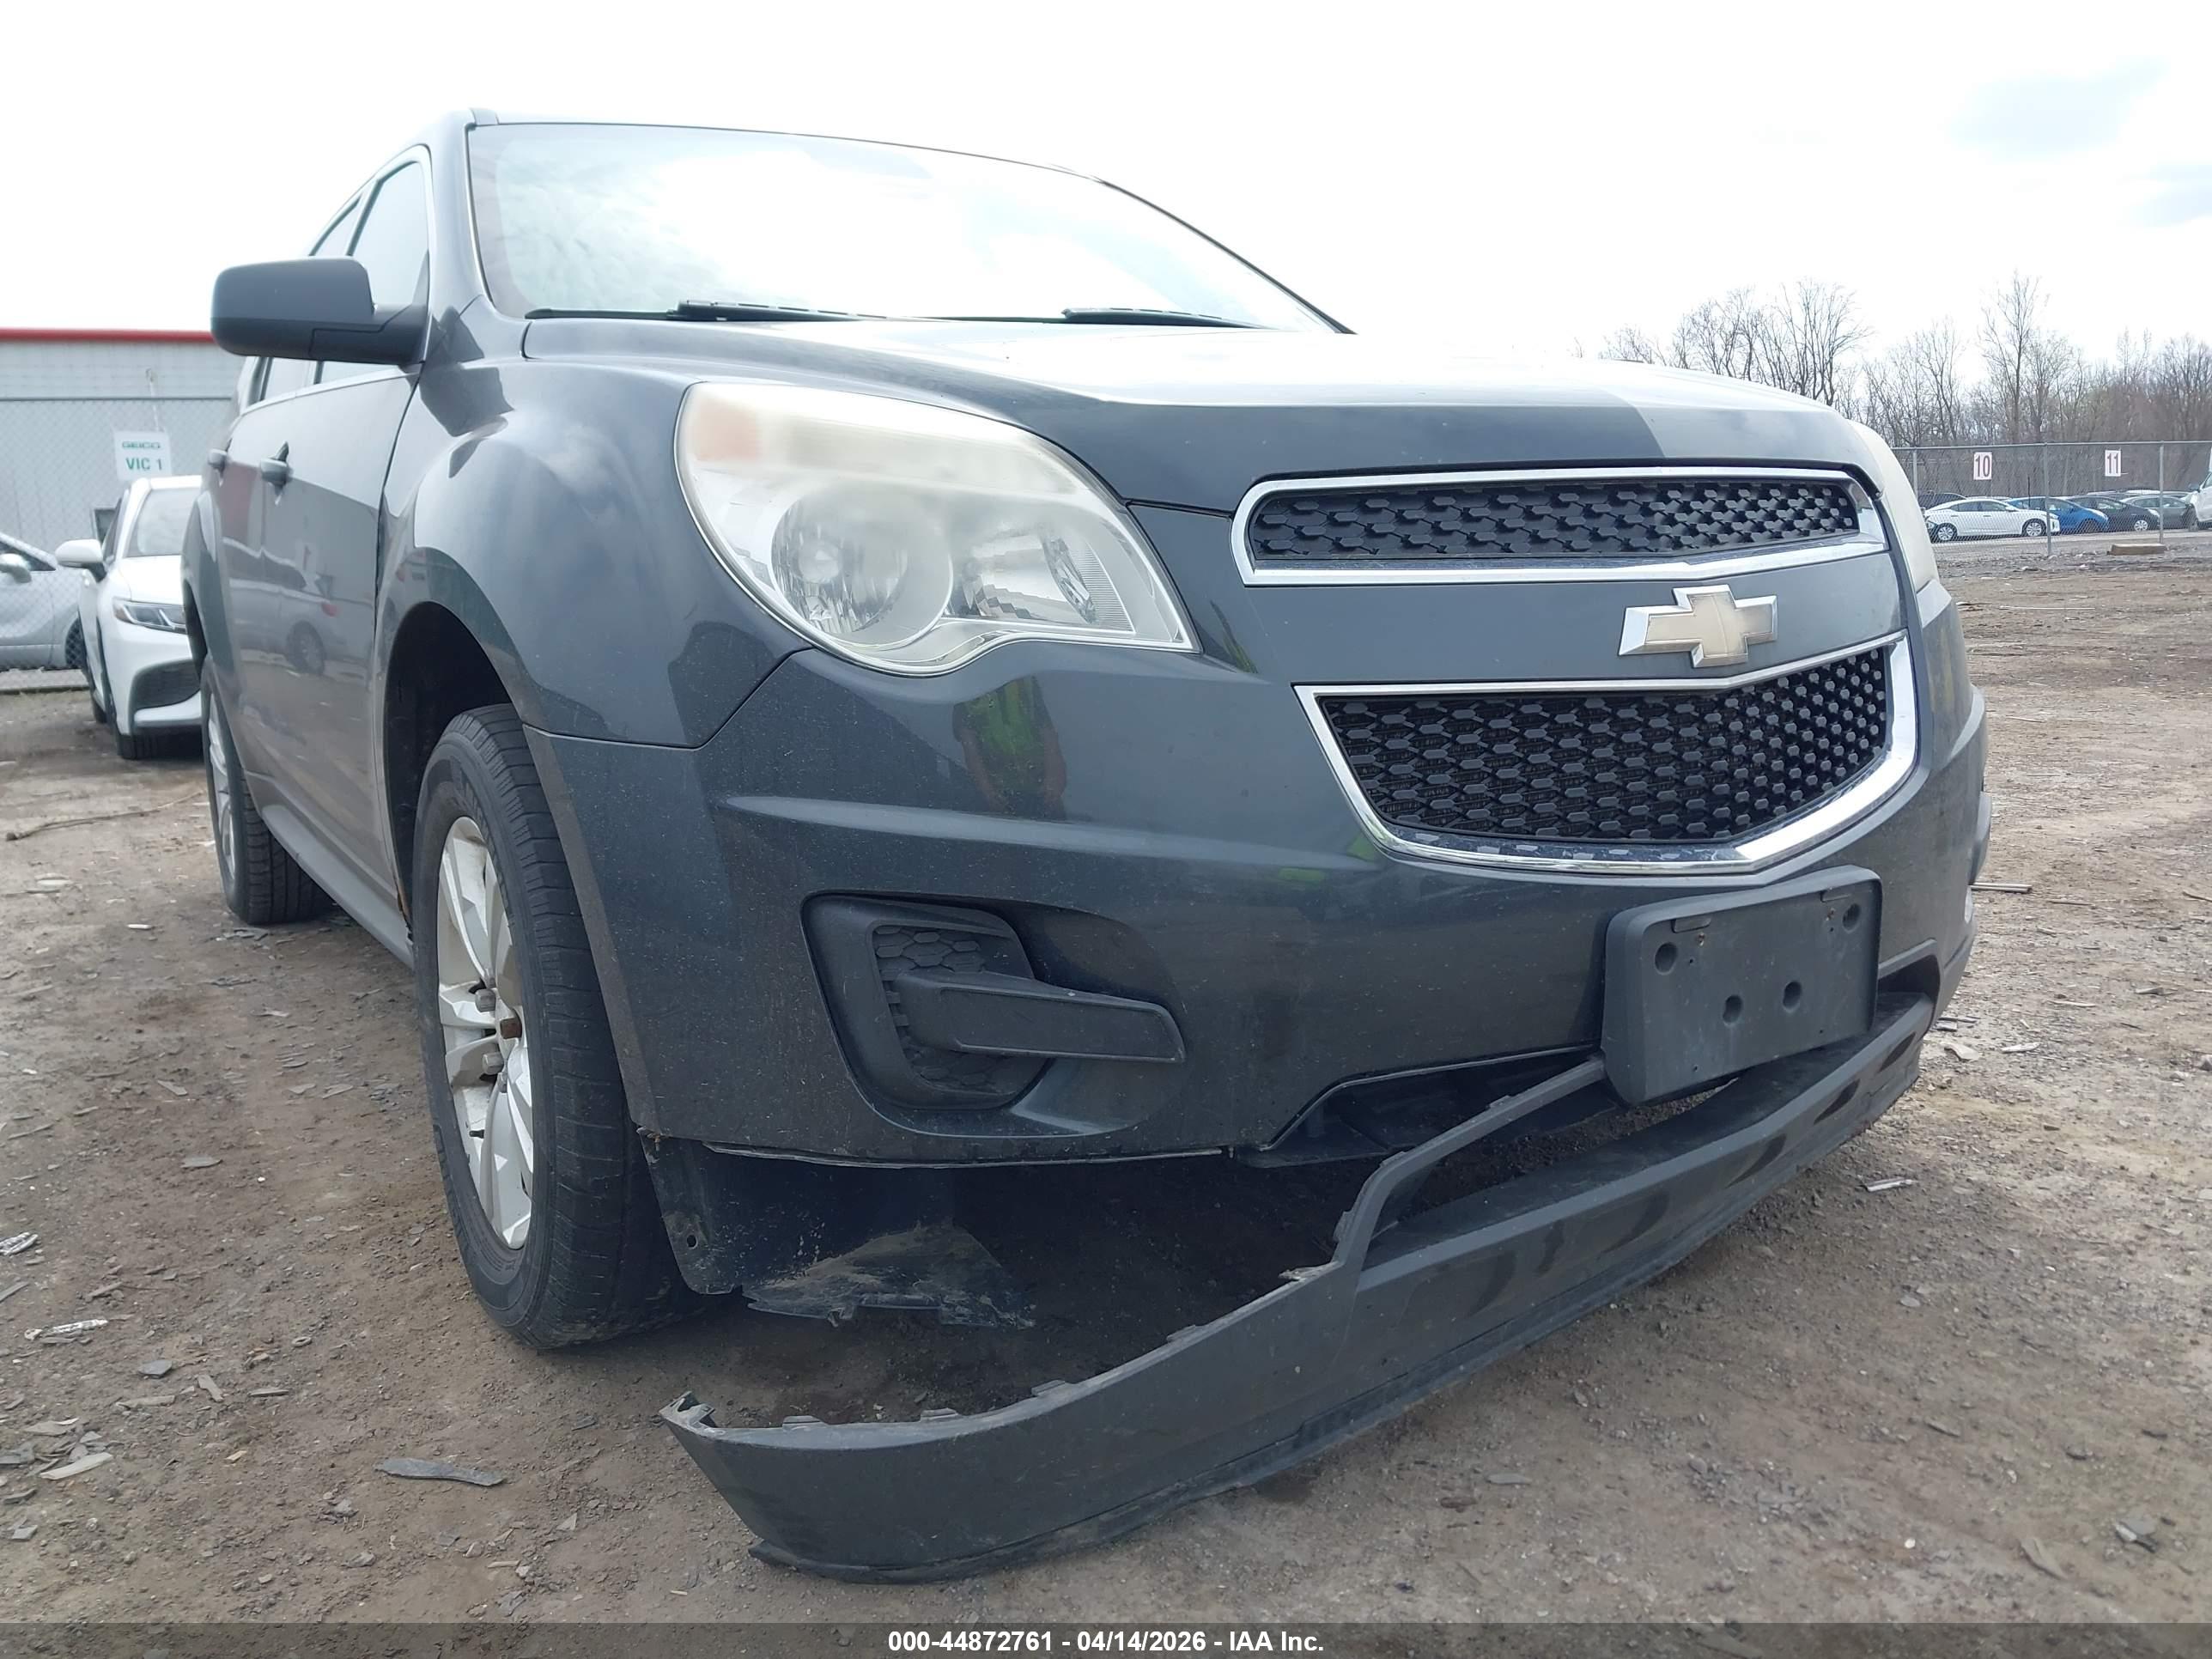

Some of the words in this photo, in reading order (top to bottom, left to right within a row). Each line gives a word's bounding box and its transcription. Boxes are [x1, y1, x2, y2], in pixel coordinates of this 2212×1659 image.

[125, 457, 150, 471] VIC
[156, 459, 162, 471] 1
[1975, 455, 1990, 477] 10
[2106, 453, 2118, 474] 11
